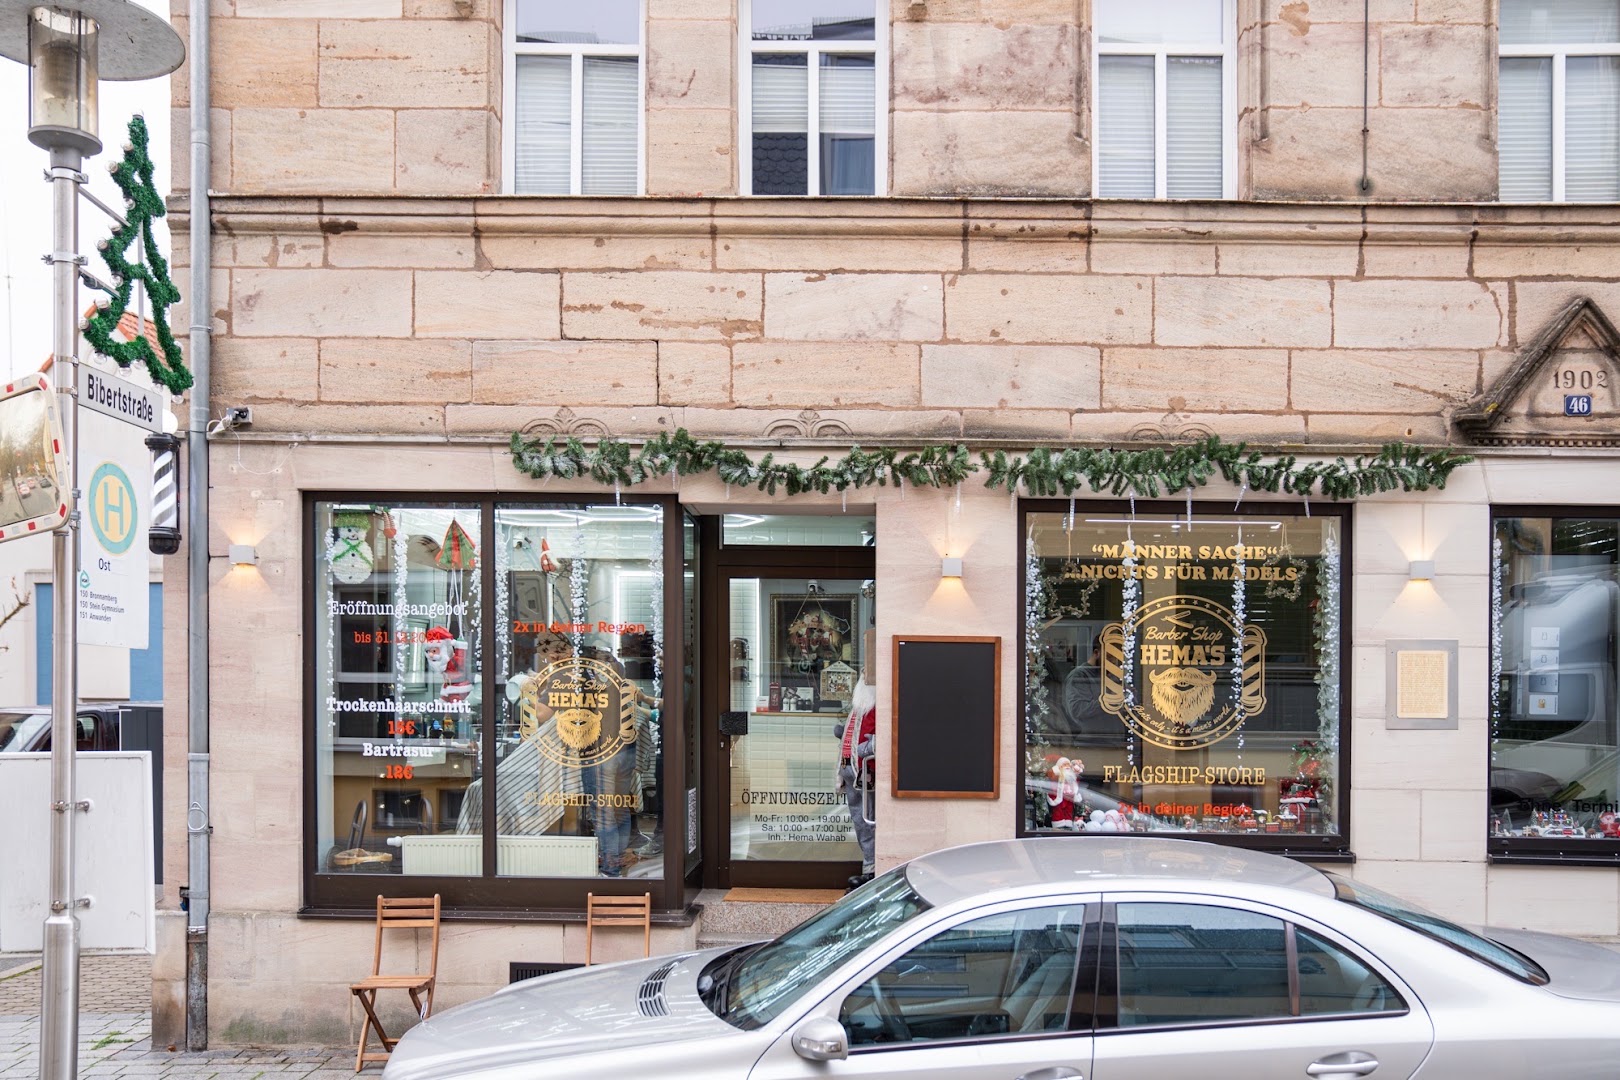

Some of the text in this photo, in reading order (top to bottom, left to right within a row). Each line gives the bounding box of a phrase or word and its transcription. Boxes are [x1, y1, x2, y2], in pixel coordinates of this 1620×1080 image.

[1553, 369, 1609, 390] 1902
[87, 372, 154, 424] Bibertstraße
[1568, 397, 1588, 414] 46
[98, 558, 111, 571] Ost
[1163, 563, 1207, 581] FÜR
[1212, 562, 1298, 581] MÄDELS
[330, 600, 468, 619] Eröffnungsangebot
[513, 620, 647, 635] 2x in deiner Region
[354, 631, 372, 644] bis
[1145, 626, 1224, 645] Barber Shop
[552, 679, 608, 694] Barber Shop
[326, 697, 471, 714] Trockenhaarschnitt
[387, 720, 415, 735] 15€
[362, 742, 434, 758] Bartrasur
[1102, 765, 1266, 786] FLAGSHIP-STORE
[1118, 802, 1253, 817] 2x in deiner Region
[754, 814, 783, 823] Mo-Fr:
[786, 815, 809, 823] 10:00
[817, 815, 841, 824] 19:00
[761, 823, 776, 832] Sa:
[779, 824, 802, 832] 10:00
[811, 824, 834, 833] 17:00
[836, 824, 852, 833] Uhr
[788, 833, 814, 842] Hema
[816, 833, 847, 842] Wahab
